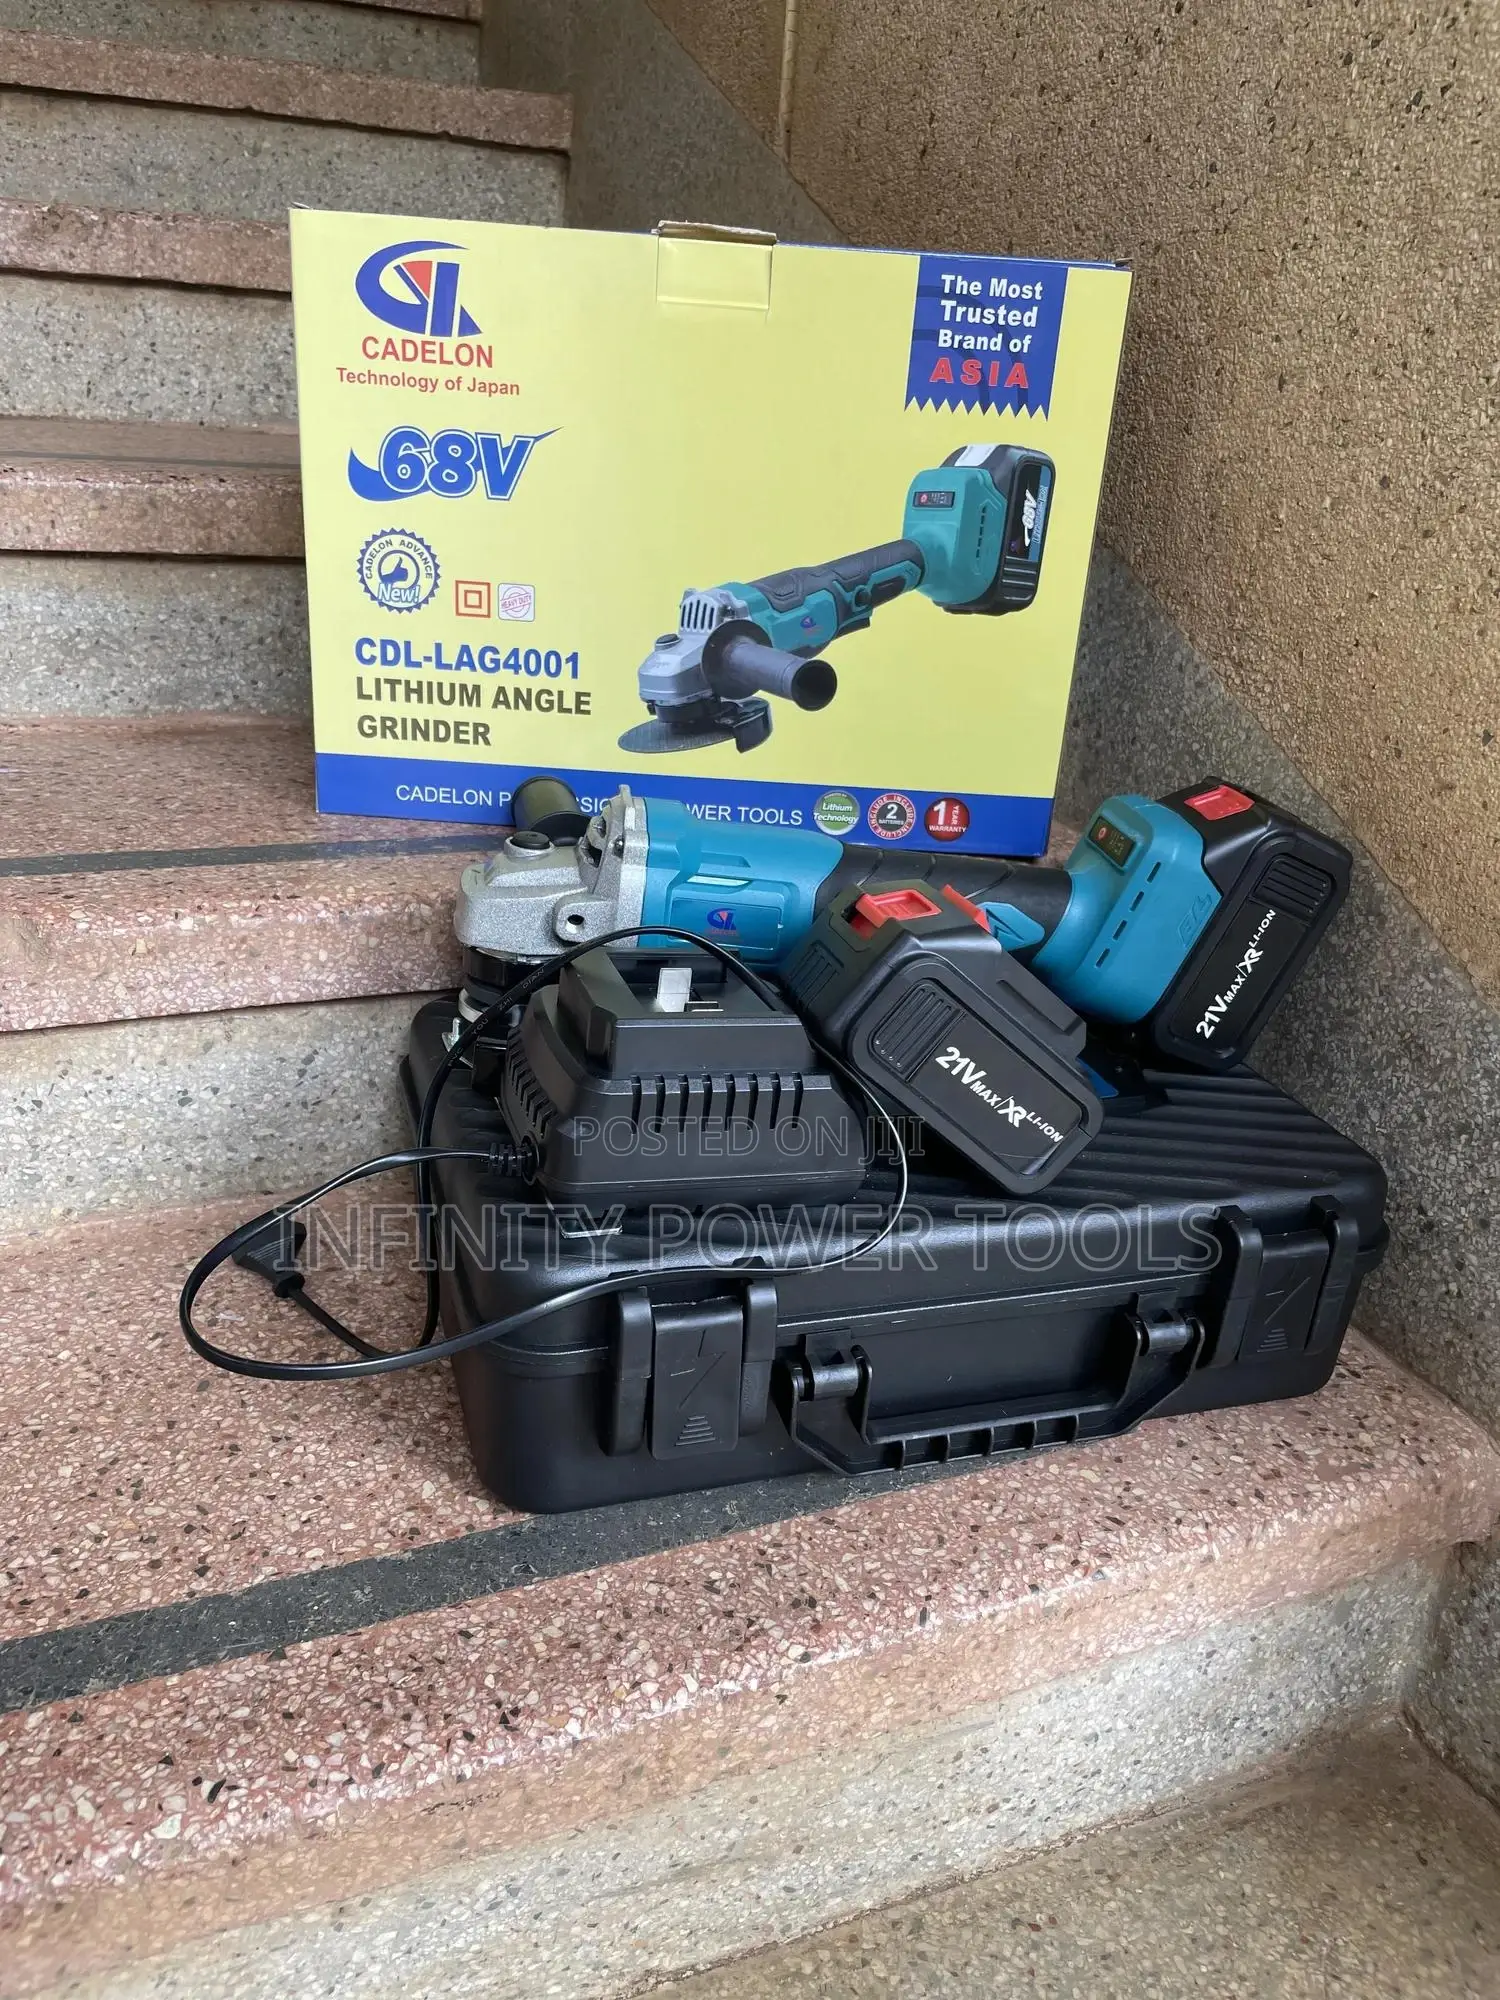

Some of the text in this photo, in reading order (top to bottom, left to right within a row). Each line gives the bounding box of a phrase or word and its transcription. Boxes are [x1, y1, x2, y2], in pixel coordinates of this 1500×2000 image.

[941, 274, 1043, 300] The Most
[940, 300, 1038, 328] Trusted
[361, 336, 494, 368] CADELON
[937, 329, 1031, 354] Brand of
[336, 367, 520, 397] Technology of Japan
[929, 357, 1029, 389] ASIA
[377, 425, 536, 501] 68V
[365, 538, 433, 580] CADELON ADVANCE
[378, 583, 420, 604] New!
[355, 637, 580, 680] CDL-LAG4001
[356, 676, 592, 716] LITHIUM ANGLE
[357, 714, 491, 746] GRINDER
[396, 784, 492, 807] CADELON
[686, 803, 731, 821] WER
[737, 806, 803, 825] TOOLS
[814, 812, 860, 825] Technology
[822, 802, 853, 812] Lithium
[885, 803, 898, 820] 2
[933, 800, 960, 826] 1 YEAR
[928, 825, 967, 833] WARRANTY
